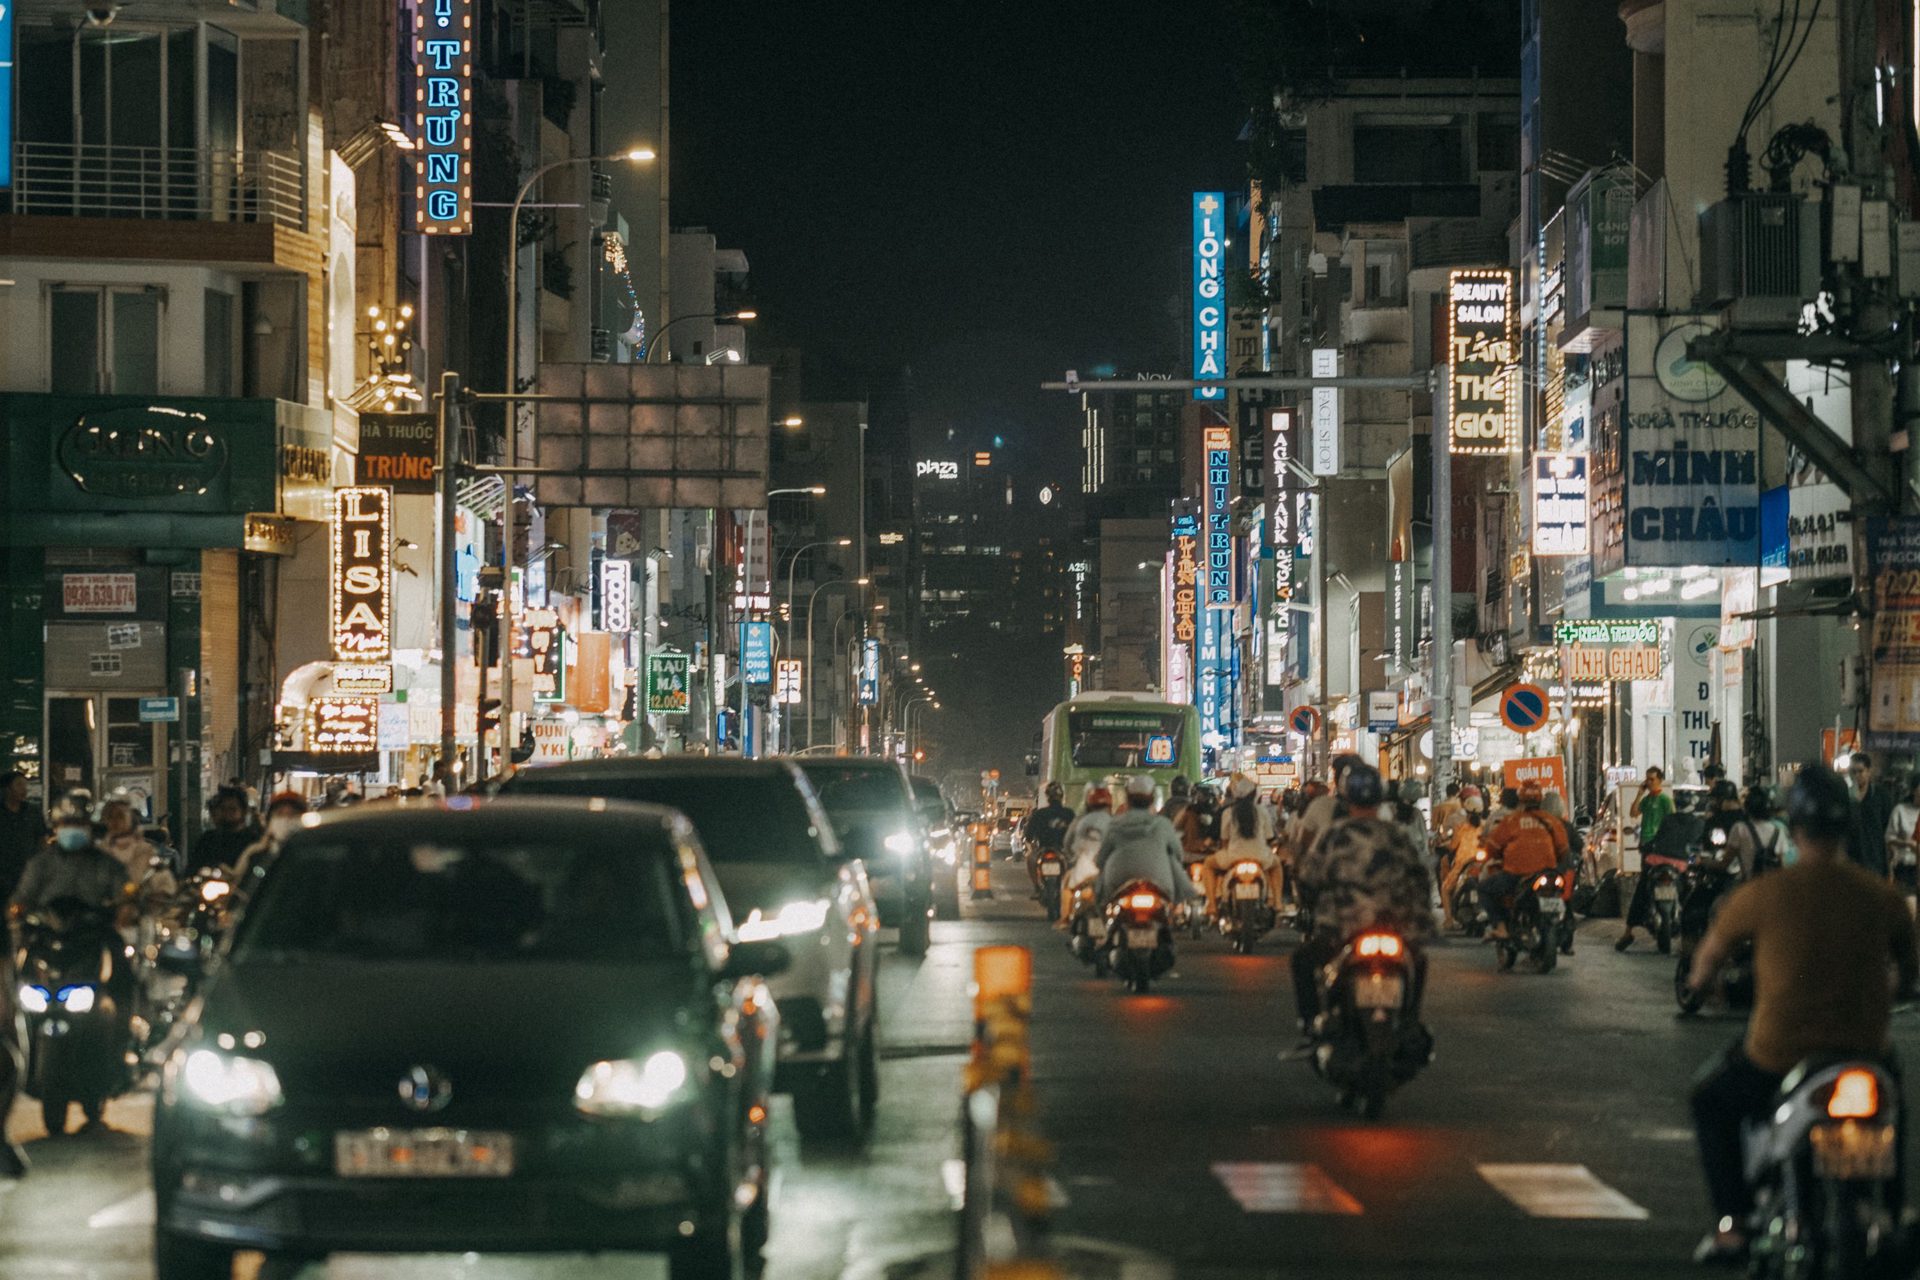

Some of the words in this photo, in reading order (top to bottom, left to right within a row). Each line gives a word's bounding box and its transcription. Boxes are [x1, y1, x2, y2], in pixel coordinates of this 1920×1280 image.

[426, 41, 461, 219] TRƯNG
[1199, 218, 1218, 298] LONG
[1453, 283, 1508, 301] BEAUTY
[1457, 305, 1505, 322] SALON
[1318, 357, 1330, 376] TH
[1319, 390, 1331, 427] FACE
[1455, 407, 1505, 439] GIỚI
[387, 421, 434, 439] THUỐC
[364, 452, 432, 479] TRƯNG
[916, 459, 958, 478] plaza
[1320, 430, 1331, 471] SHOP
[1632, 440, 1756, 485] MINH
[1210, 450, 1229, 509] NHỊ
[1631, 496, 1758, 541] CHÂU
[341, 494, 383, 630] LISA
[1210, 514, 1232, 602] TRƯNG
